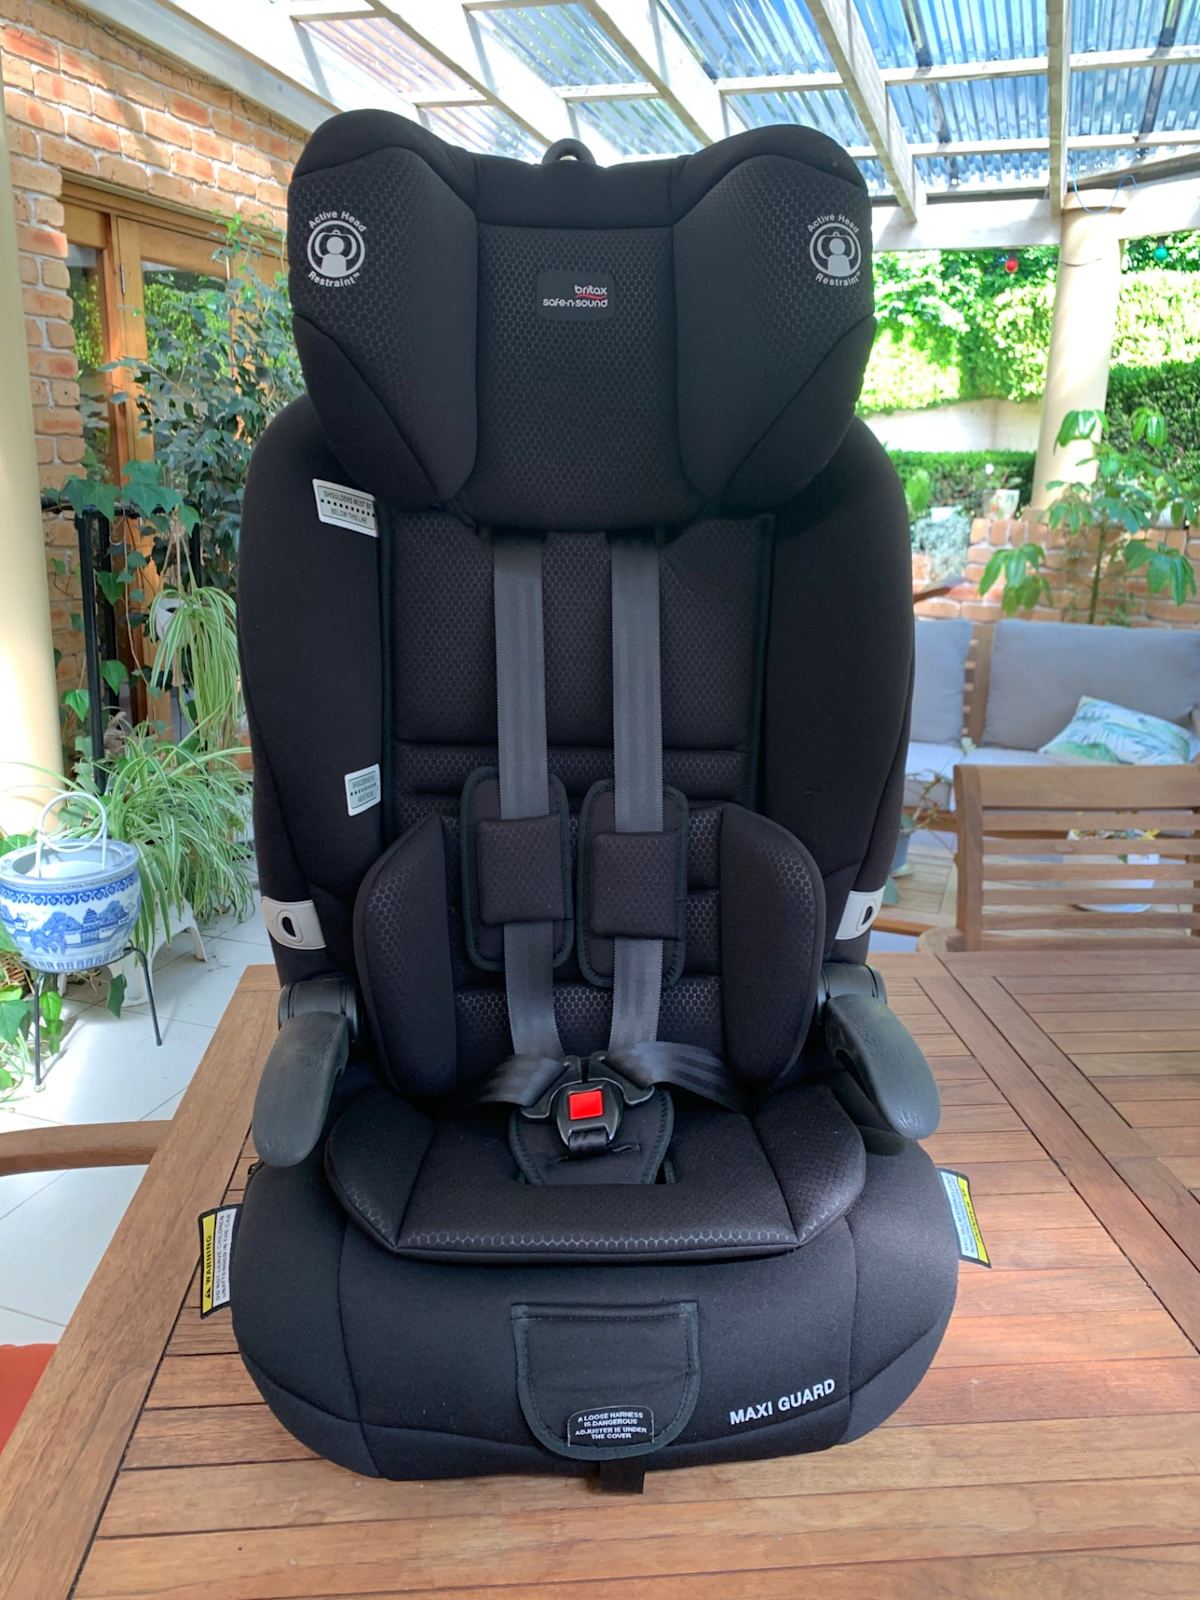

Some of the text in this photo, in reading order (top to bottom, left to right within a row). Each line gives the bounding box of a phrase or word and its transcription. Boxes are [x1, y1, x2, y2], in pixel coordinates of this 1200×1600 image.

[308, 211, 367, 232] Active Head
[807, 214, 860, 233] Active Head
[574, 284, 608, 295] britax
[729, 1378, 836, 1425] MAXI GUARD
[583, 1412, 609, 1422] LOOSE
[610, 1411, 643, 1419] HARNESS
[592, 1418, 638, 1427] DANGEROUS
[575, 1427, 613, 1436] ADJUSTER
[622, 1426, 648, 1434] UNDER
[606, 1432, 632, 1440] COVER
